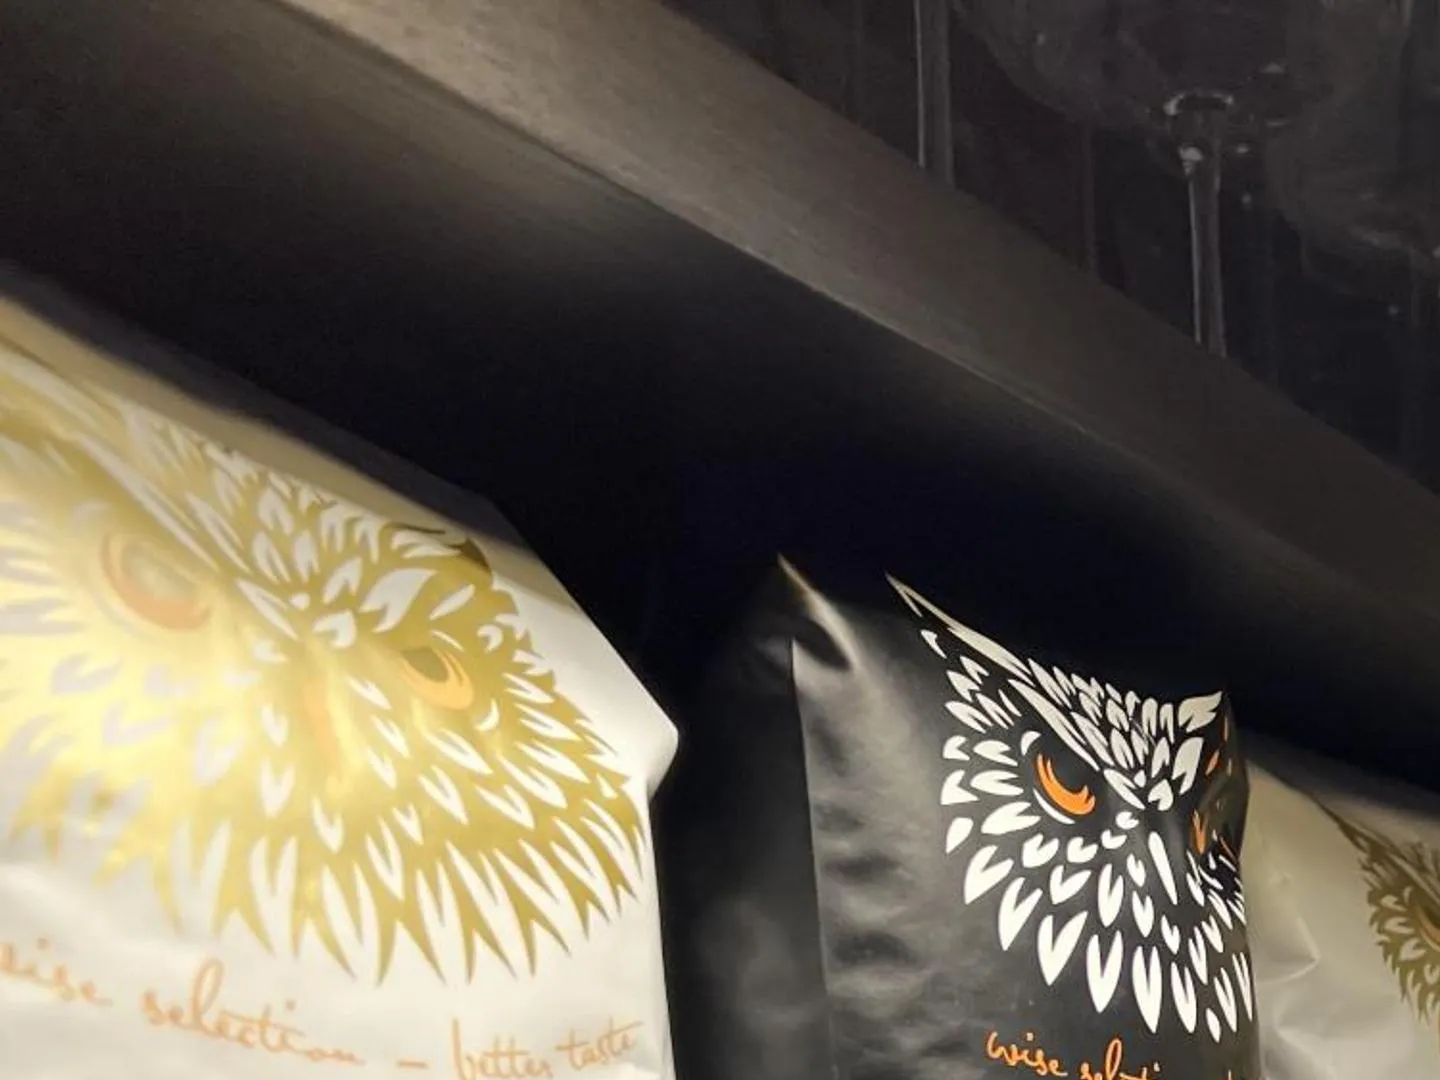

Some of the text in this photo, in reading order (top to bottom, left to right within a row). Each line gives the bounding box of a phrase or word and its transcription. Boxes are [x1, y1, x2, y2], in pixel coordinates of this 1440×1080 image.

[141, 957, 366, 1067] selection
[555, 1018, 645, 1072] taste
[985, 1030, 1068, 1077] wise
